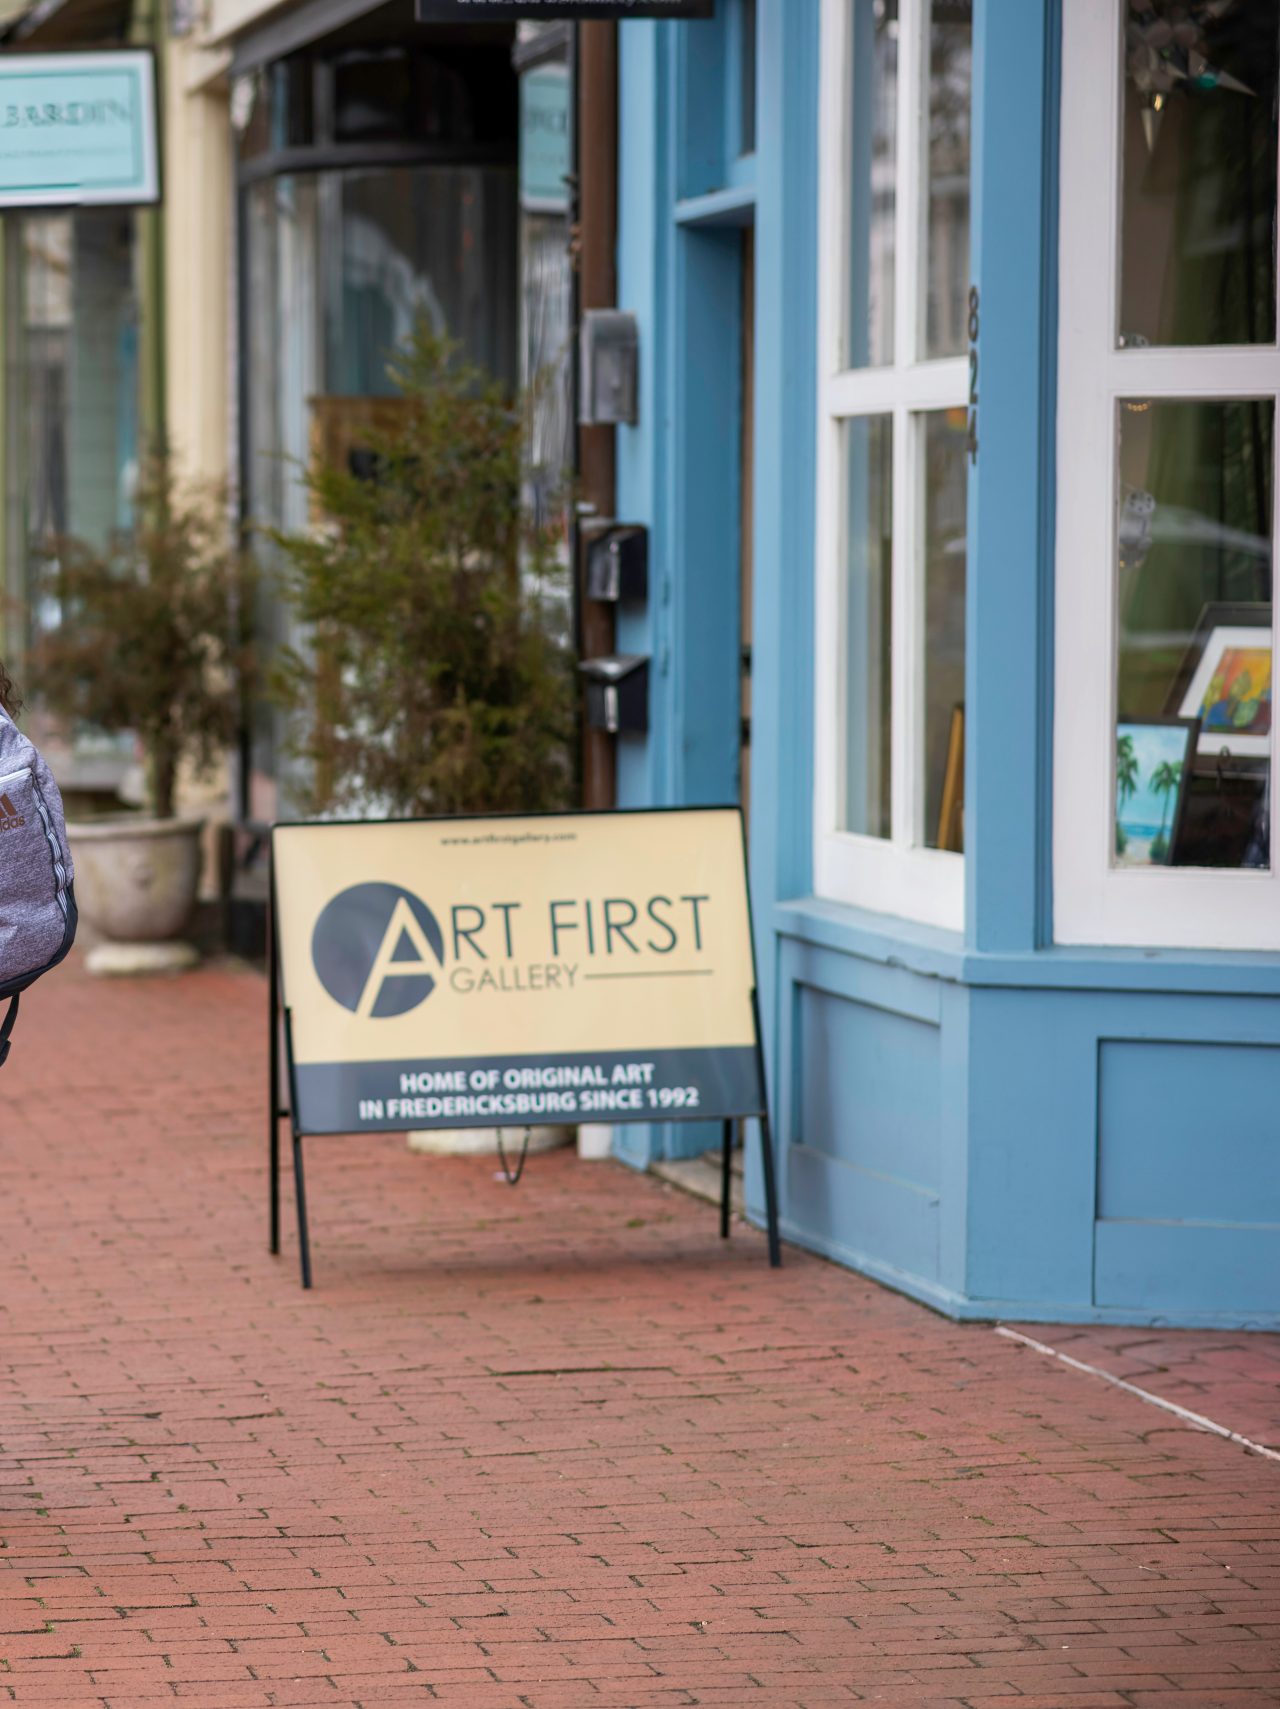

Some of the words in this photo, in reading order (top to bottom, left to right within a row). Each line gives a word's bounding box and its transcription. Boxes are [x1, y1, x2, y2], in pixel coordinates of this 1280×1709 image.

[968, 285, 979, 466] 824
[354, 895, 521, 1018] ART
[549, 895, 710, 957] FIRST
[449, 962, 579, 995] GALLERY
[399, 1070, 468, 1094] HOME
[469, 1069, 501, 1091] OF
[503, 1065, 608, 1090] ORIGINAL
[611, 1063, 655, 1085] ART
[359, 1099, 384, 1121] IN
[386, 1092, 577, 1119] FREDERICKSBURG
[579, 1088, 644, 1112] SINCE
[646, 1086, 700, 1108] 1992
